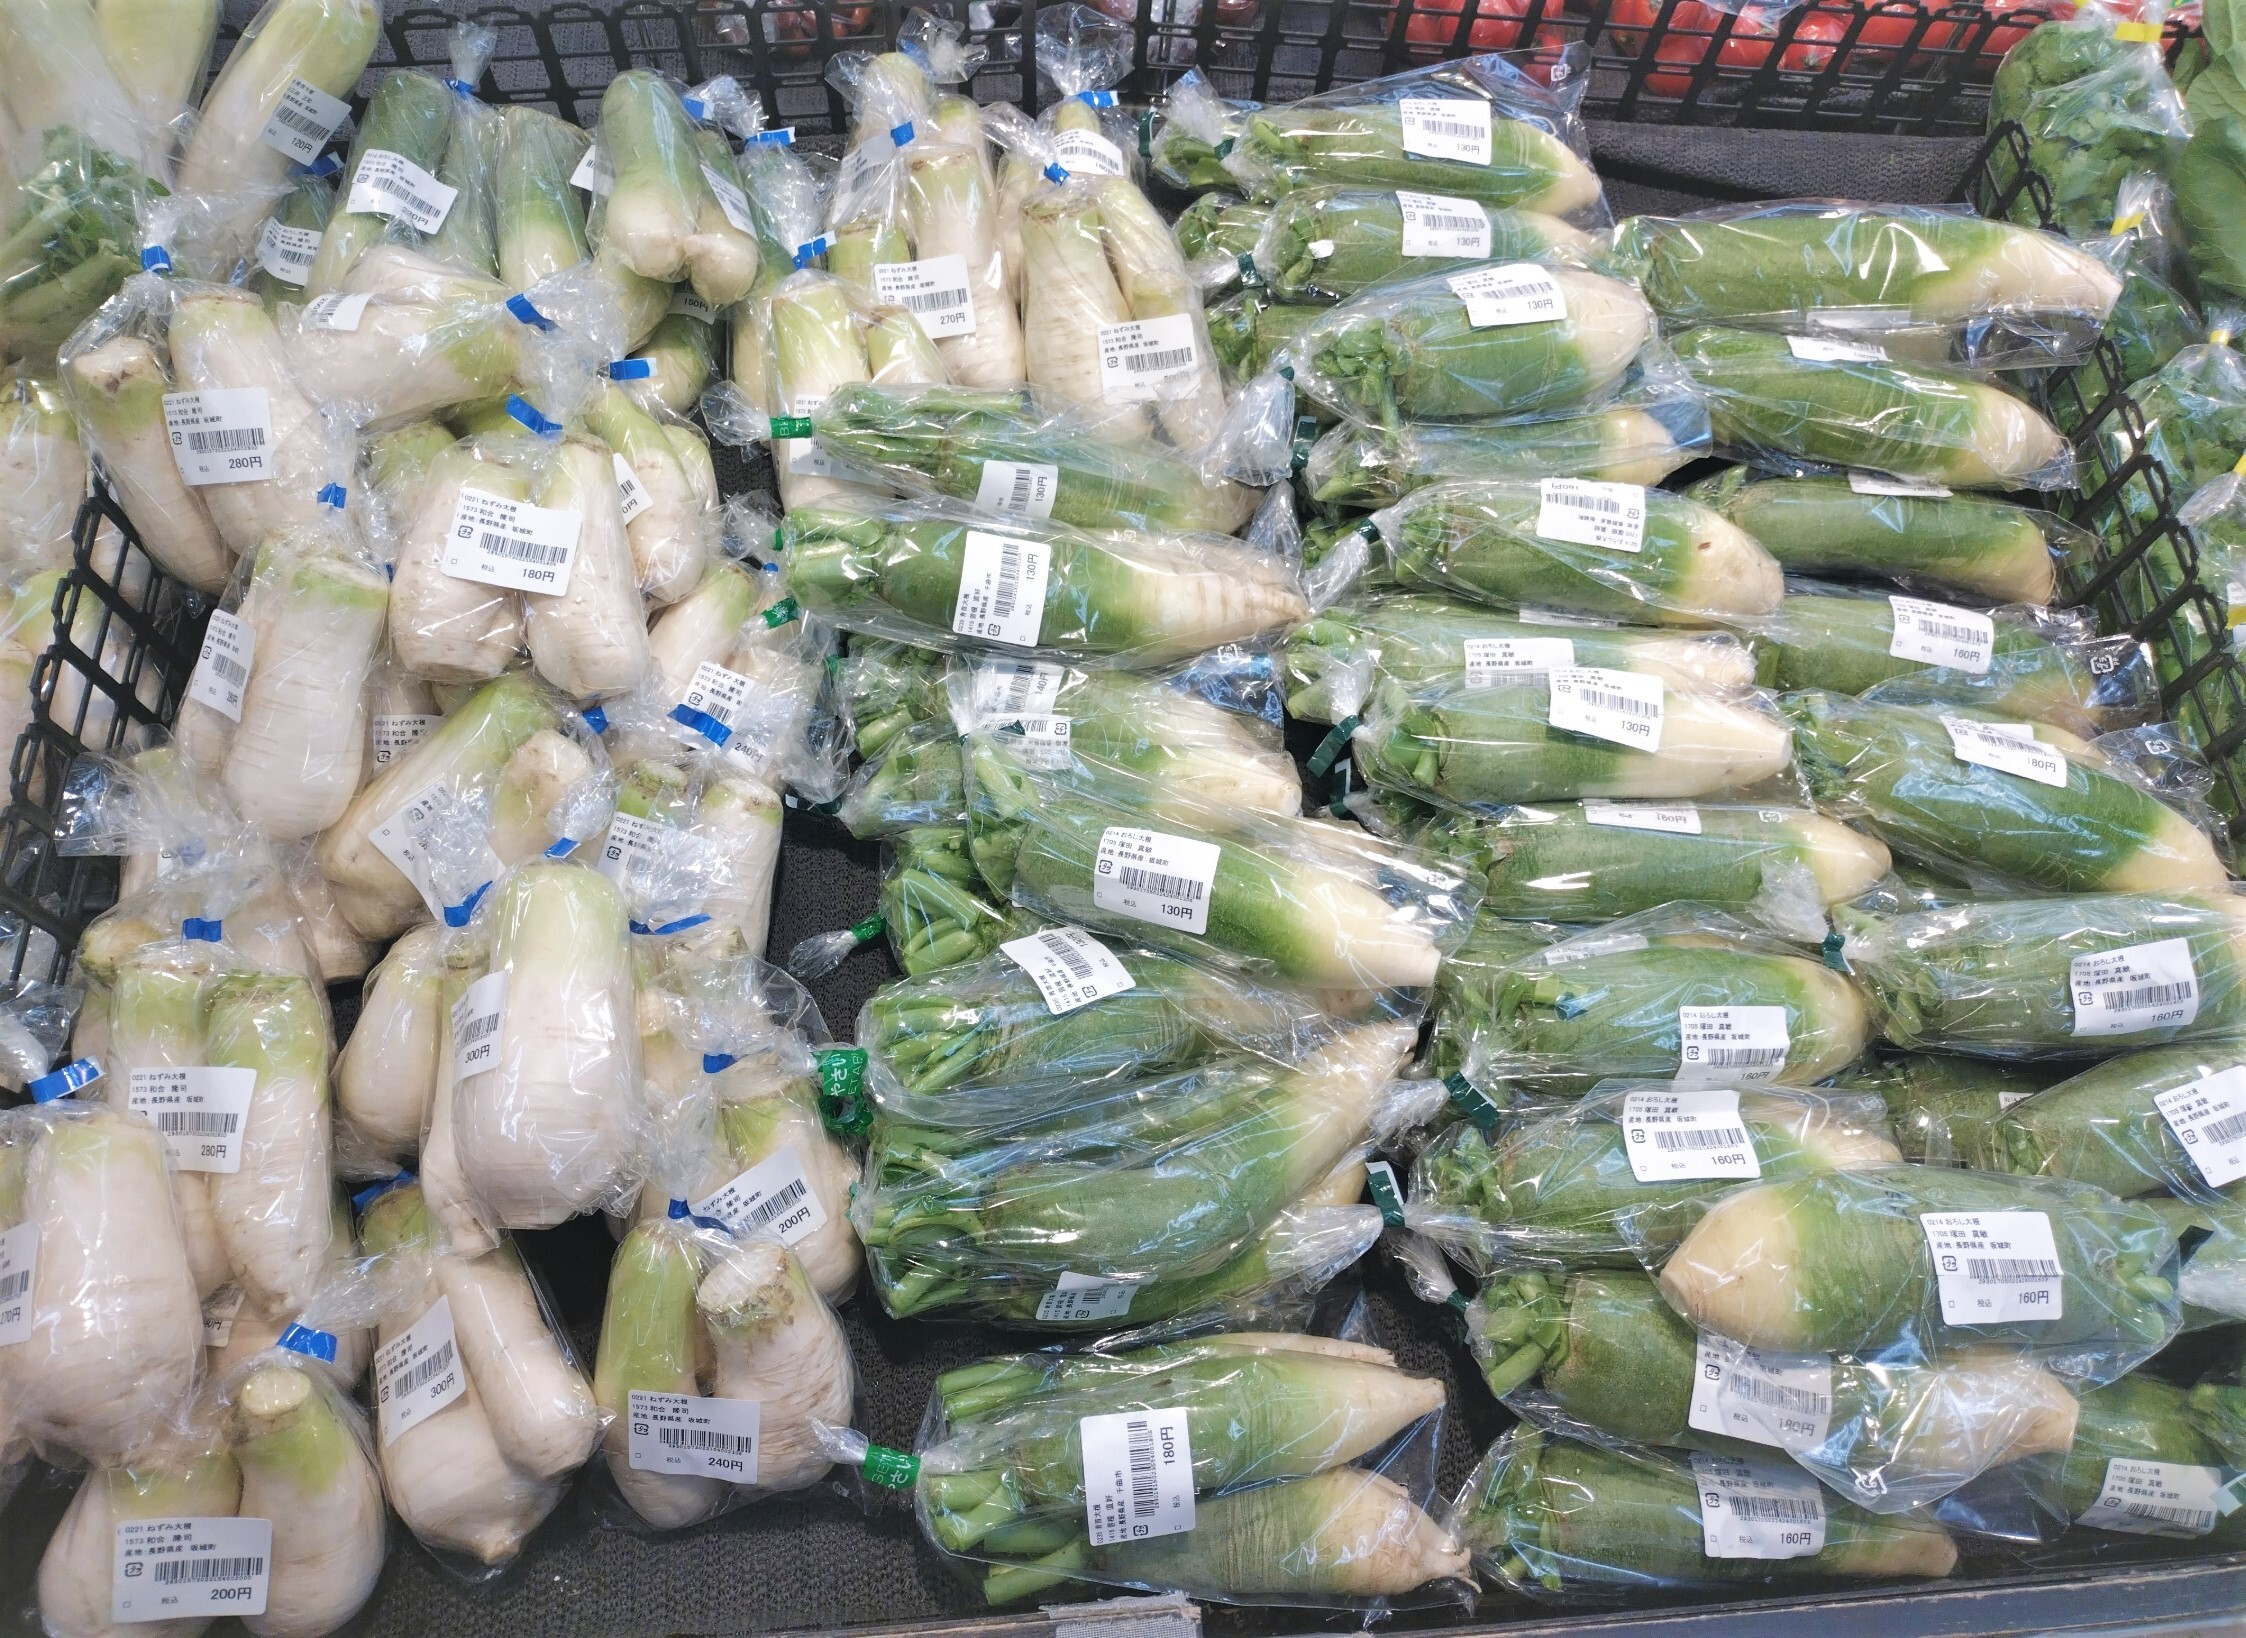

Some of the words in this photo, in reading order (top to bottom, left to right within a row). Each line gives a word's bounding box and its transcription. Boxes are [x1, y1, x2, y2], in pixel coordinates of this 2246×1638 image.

[291, 138, 313, 154] 120円
[1457, 143, 1480, 154] 130円
[1457, 237, 1480, 248] 130円
[1527, 299, 1554, 310] 130円
[940, 312, 966, 325] 270円
[228, 456, 263, 469] 280円
[1035, 476, 1048, 502] 130円
[481, 499, 517, 513] ねずみ大根
[1026, 554, 1039, 581] 130円
[522, 568, 555, 583] 180円
[1954, 648, 1980, 662] 160円
[1621, 720, 1650, 737] 130円
[616, 816, 629, 825] 0221
[1103, 838, 1116, 846] 1705
[1121, 832, 1152, 843] おろし大根
[1161, 904, 1193, 920] 130円
[2093, 954, 2125, 966] おろし大根
[2151, 1009, 2184, 1022] 160円
[465, 1044, 490, 1064] 300円
[149, 1072, 186, 1081] ねずみ大根
[1740, 1071, 1770, 1080] 160円
[1646, 1096, 1678, 1104] おろし大根
[201, 1145, 227, 1158] 280円
[1710, 1153, 1746, 1165] 160円
[778, 1206, 811, 1234] 200円
[1945, 1218, 1980, 1226] おろし大根
[1950, 1230, 1966, 1238] 塚田
[1977, 1299, 1992, 1307] 税込
[2019, 1290, 2049, 1304] 160円
[430, 1372, 455, 1398] 300円
[650, 1396, 688, 1405] ねずみ大根
[1160, 1426, 1176, 1466] 180円
[666, 1456, 681, 1464] 税込
[708, 1457, 743, 1472] 240円
[2130, 1466, 2160, 1476] おろし大根
[1172, 1495, 1180, 1508] 税込
[125, 1526, 143, 1534] 0221
[147, 1522, 192, 1532] ねずみ大根
[125, 1537, 143, 1545] 1573
[146, 1536, 165, 1544] 和合
[1108, 1529, 1116, 1542] 1415
[1739, 1536, 1753, 1544] 税込
[1780, 1532, 1811, 1545] 160円
[161, 1596, 179, 1604] 税込
[210, 1587, 252, 1600] 200円
